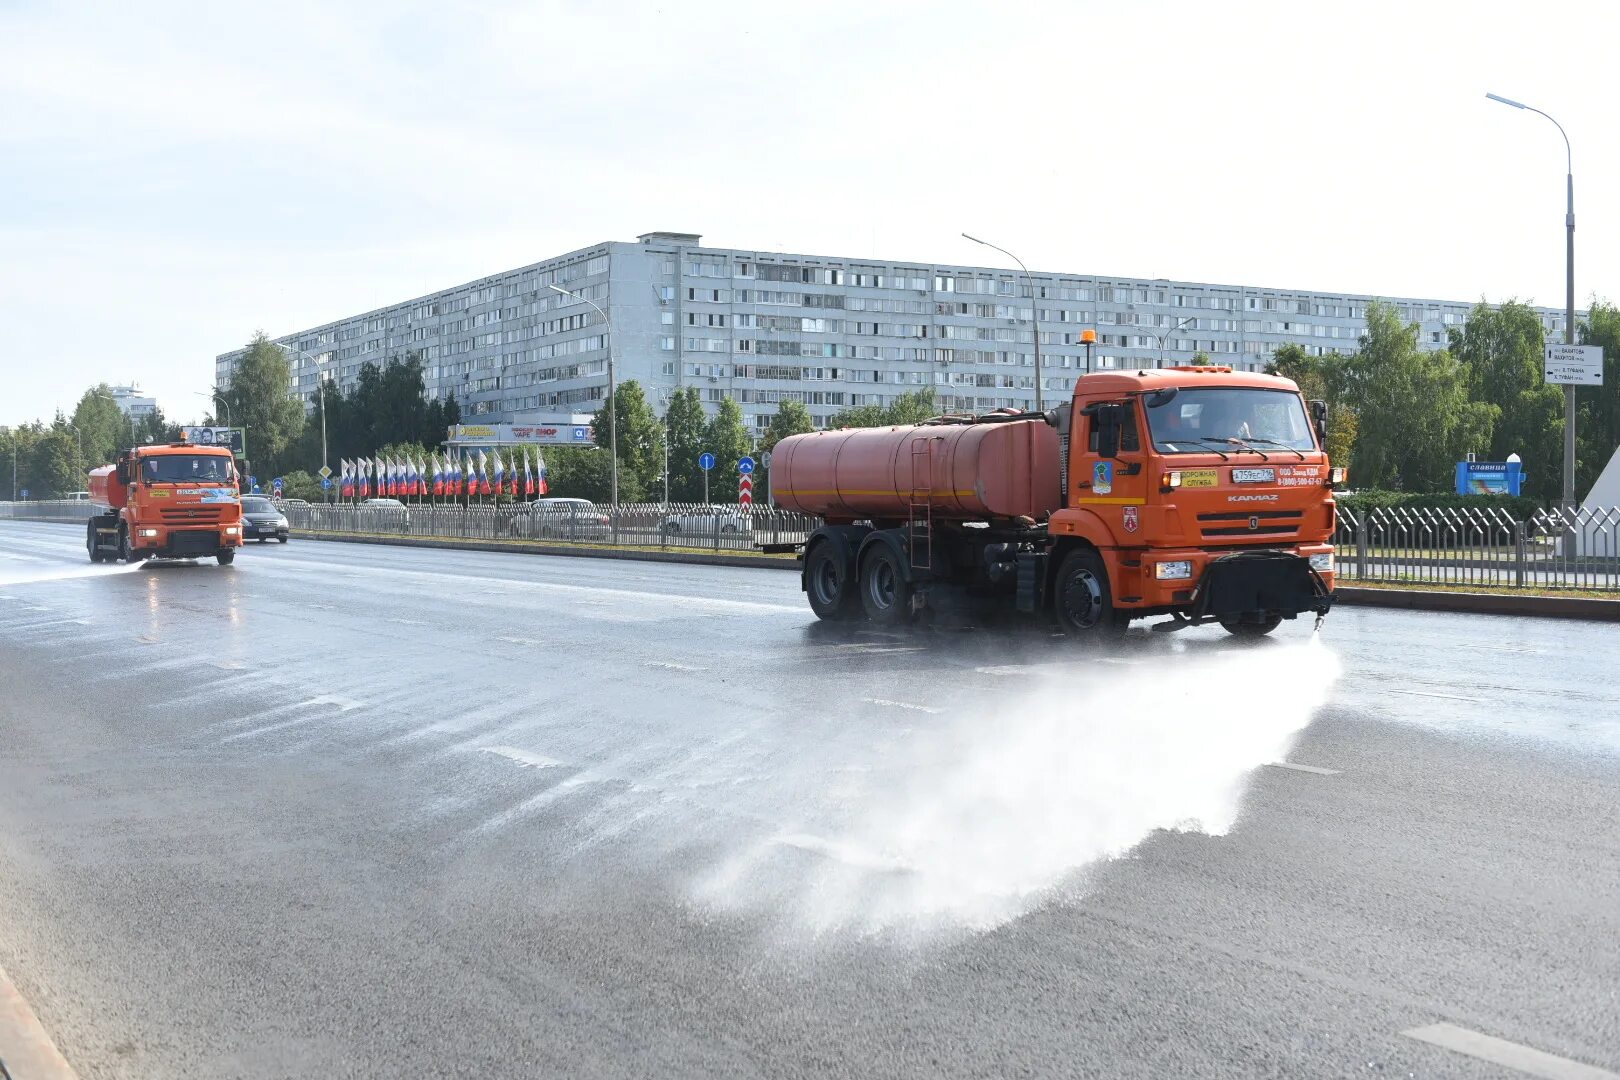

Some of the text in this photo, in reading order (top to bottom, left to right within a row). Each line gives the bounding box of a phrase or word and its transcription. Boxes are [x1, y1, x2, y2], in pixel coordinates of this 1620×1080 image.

[1181, 470, 1216, 478] ДОРОЖНАЯ
[1187, 479, 1212, 487] СЛУЖБА
[1227, 494, 1279, 502] KAMAZ
